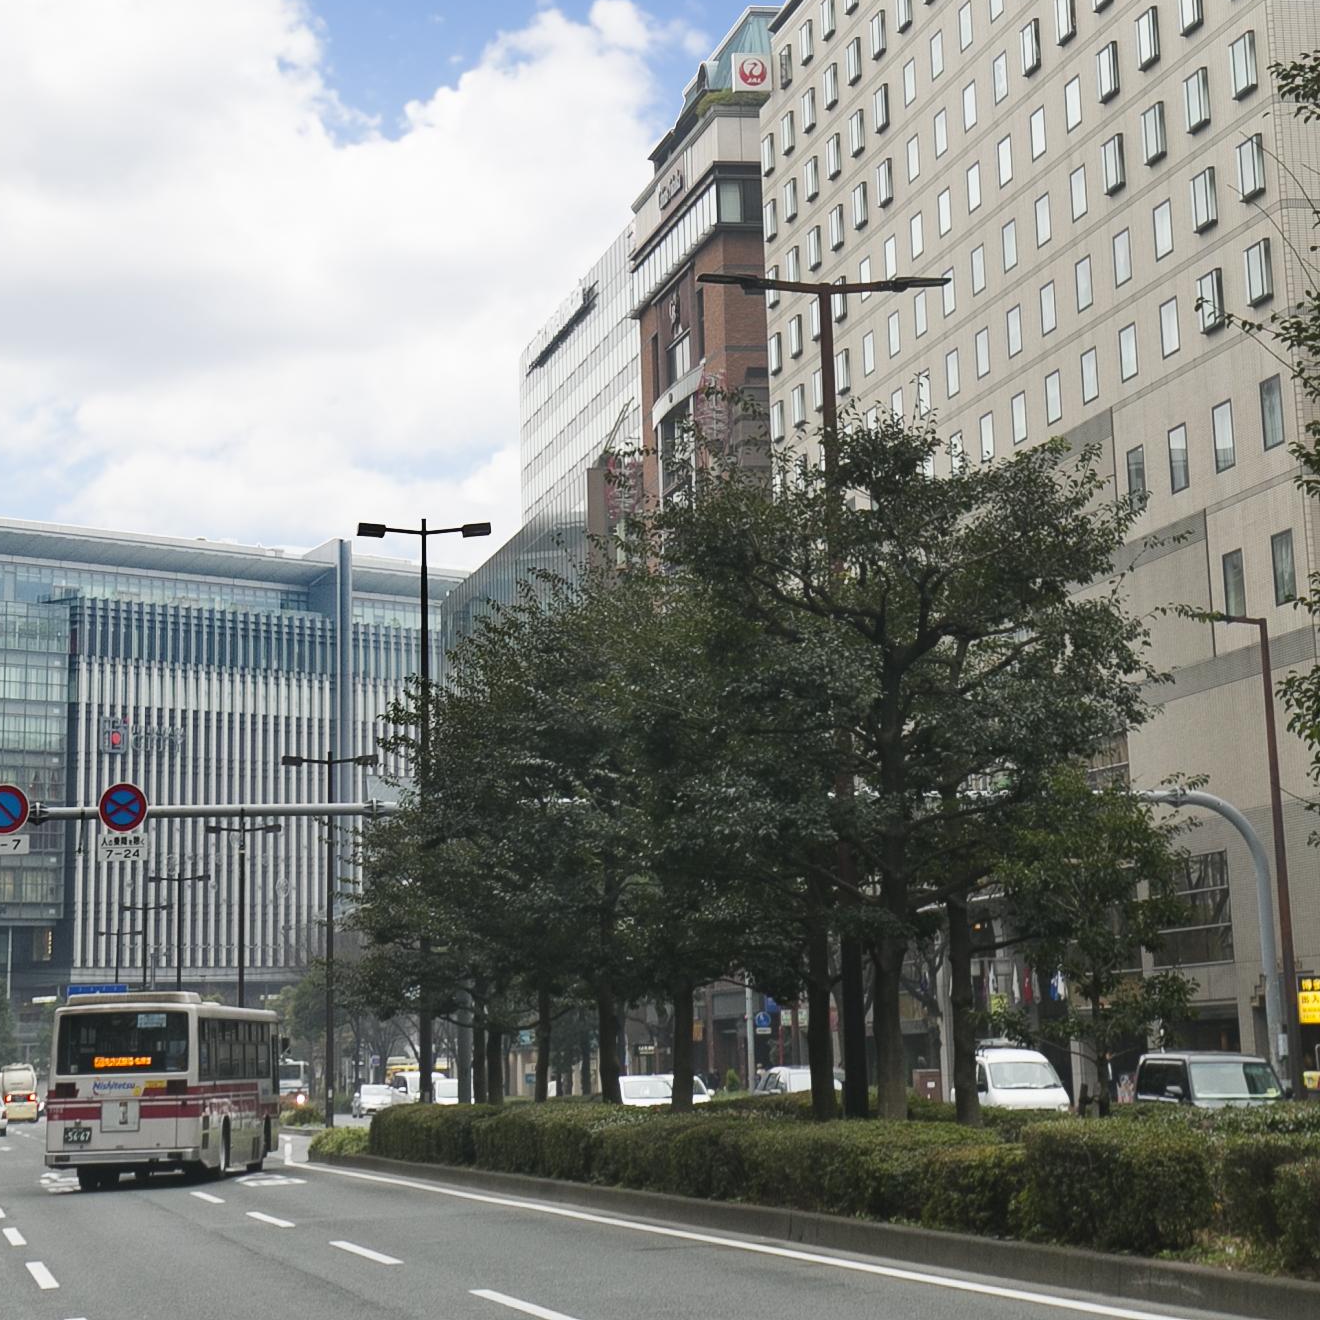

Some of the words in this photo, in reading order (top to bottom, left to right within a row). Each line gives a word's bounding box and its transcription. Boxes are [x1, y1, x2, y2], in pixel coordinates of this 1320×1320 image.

[101, 835, 145, 846] 人の乗降を除く
[106, 848, 140, 858] 7-24
[93, 1081, 136, 1091] Nishitetsu
